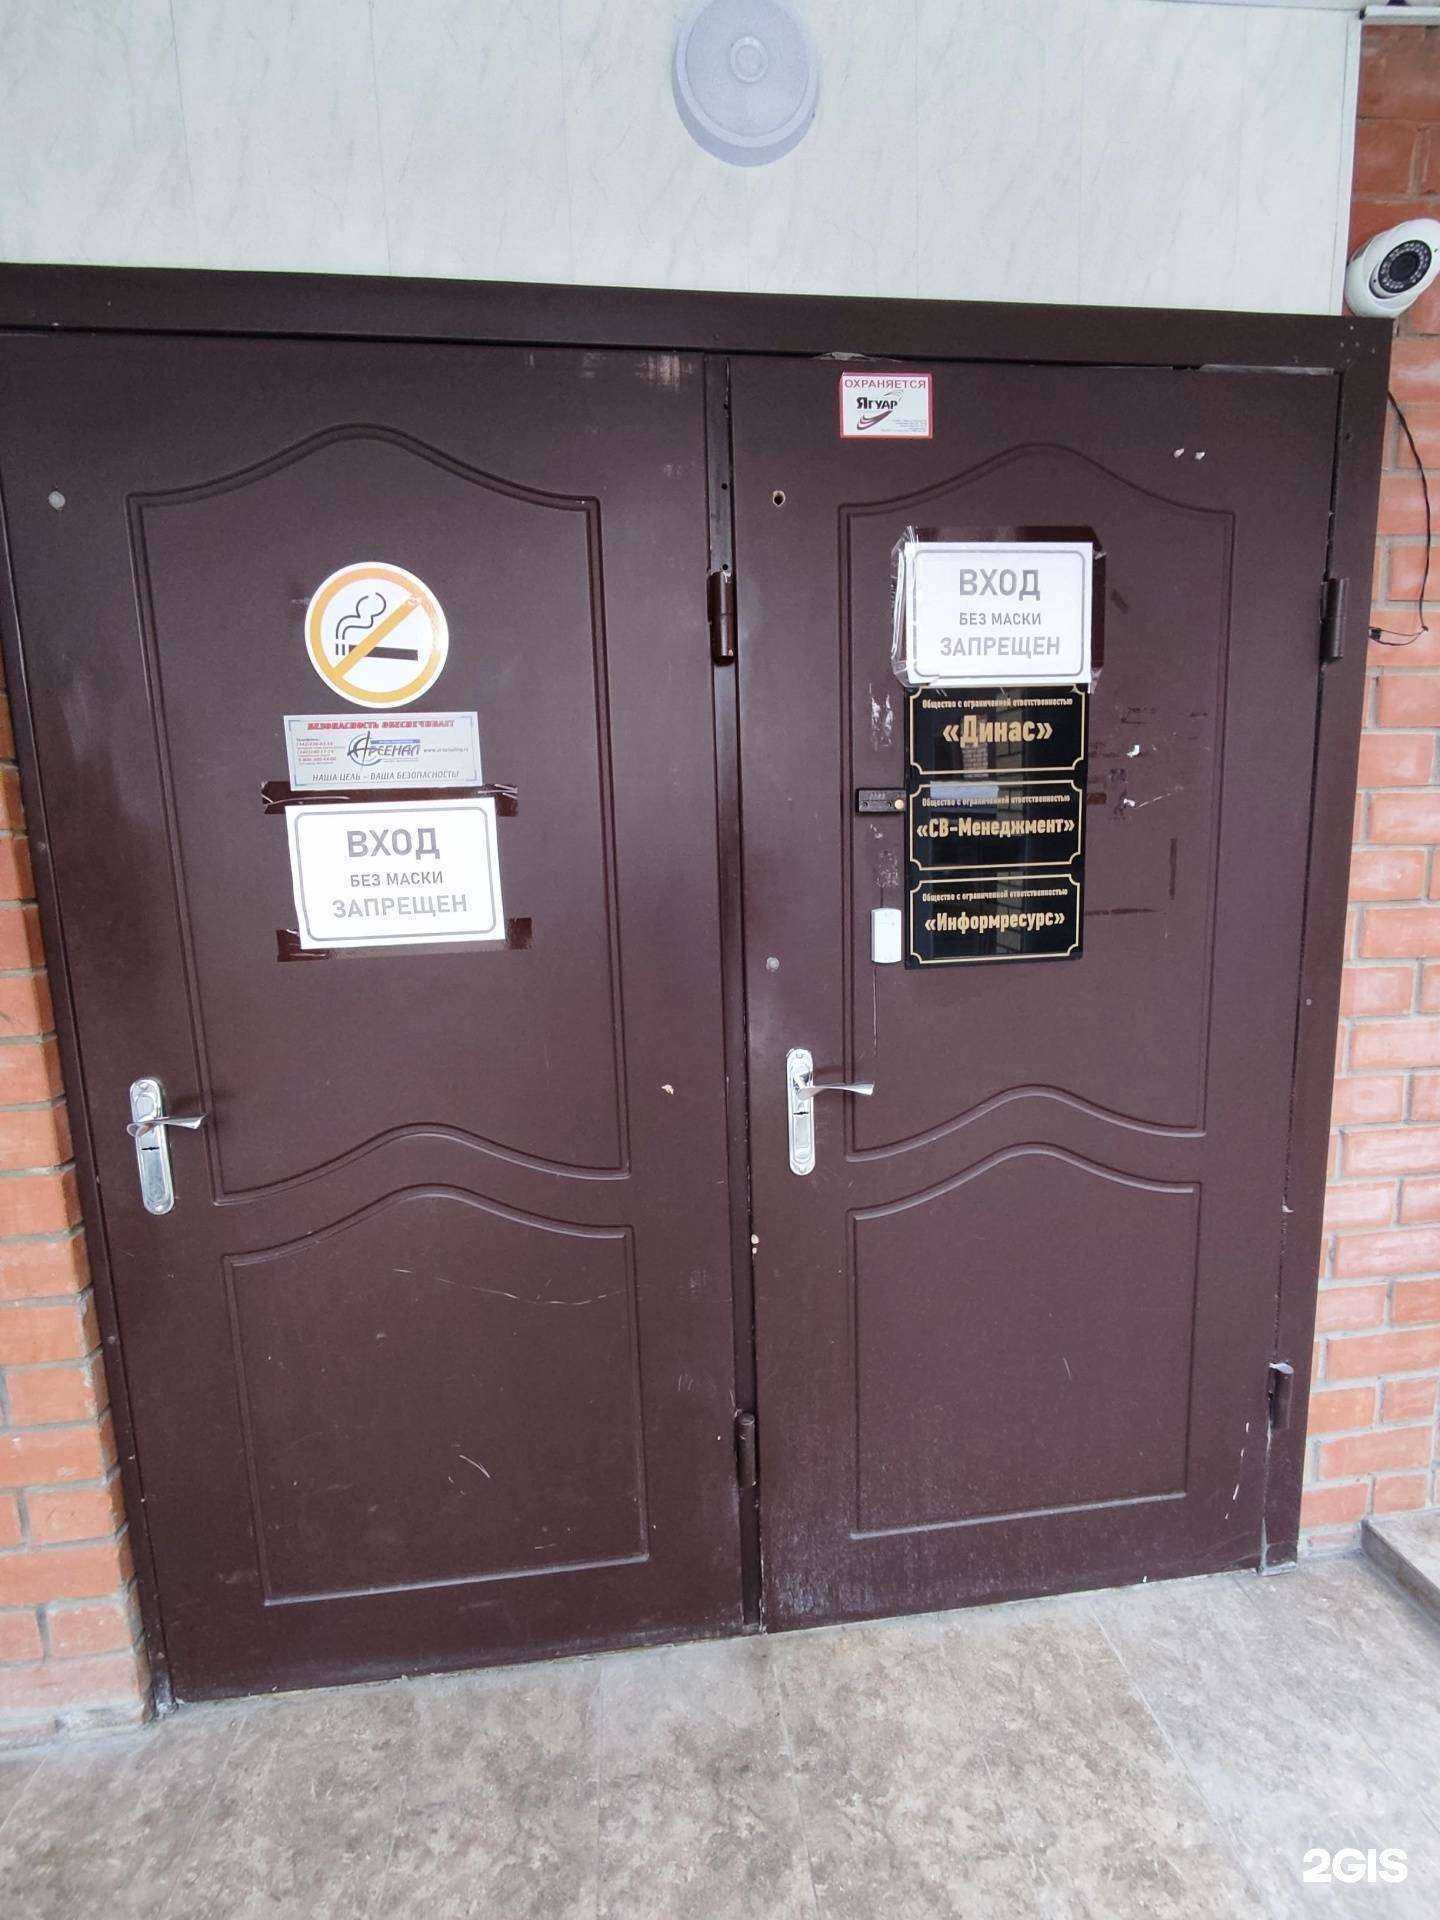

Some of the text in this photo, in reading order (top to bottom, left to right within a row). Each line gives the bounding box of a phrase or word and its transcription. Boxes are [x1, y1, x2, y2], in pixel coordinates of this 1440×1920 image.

[844, 379, 926, 389] ОХРАНЯЕТСЯ
[959, 568, 1041, 601] ВХОД
[959, 612, 1042, 625] БЕЗ МАСКИ
[940, 636, 1060, 659] ЗАПРЕЩЕН
[922, 700, 956, 709] Общество
[963, 698, 1011, 708] ограниченной
[1012, 698, 1074, 706] ответственностью
[942, 715, 1053, 748] «Динас»
[312, 773, 338, 782] НАША
[339, 772, 361, 783] ЦЕЛЬ
[370, 771, 395, 780] ВАША
[922, 798, 956, 807] Общество
[962, 796, 1010, 806] ограниченной
[1011, 795, 1070, 803] ответственностью
[916, 817, 1075, 838] «СВ-Менеджмент»
[346, 828, 441, 860] ВХОД
[350, 871, 443, 888] БЕЗ МАСКИ
[922, 893, 955, 902] Общество
[962, 891, 1008, 901] ограниченной
[1009, 889, 1067, 898] ответственностью
[332, 894, 467, 918] ЗАПРЕЩЕН
[924, 911, 1066, 935] «Информресурс»
